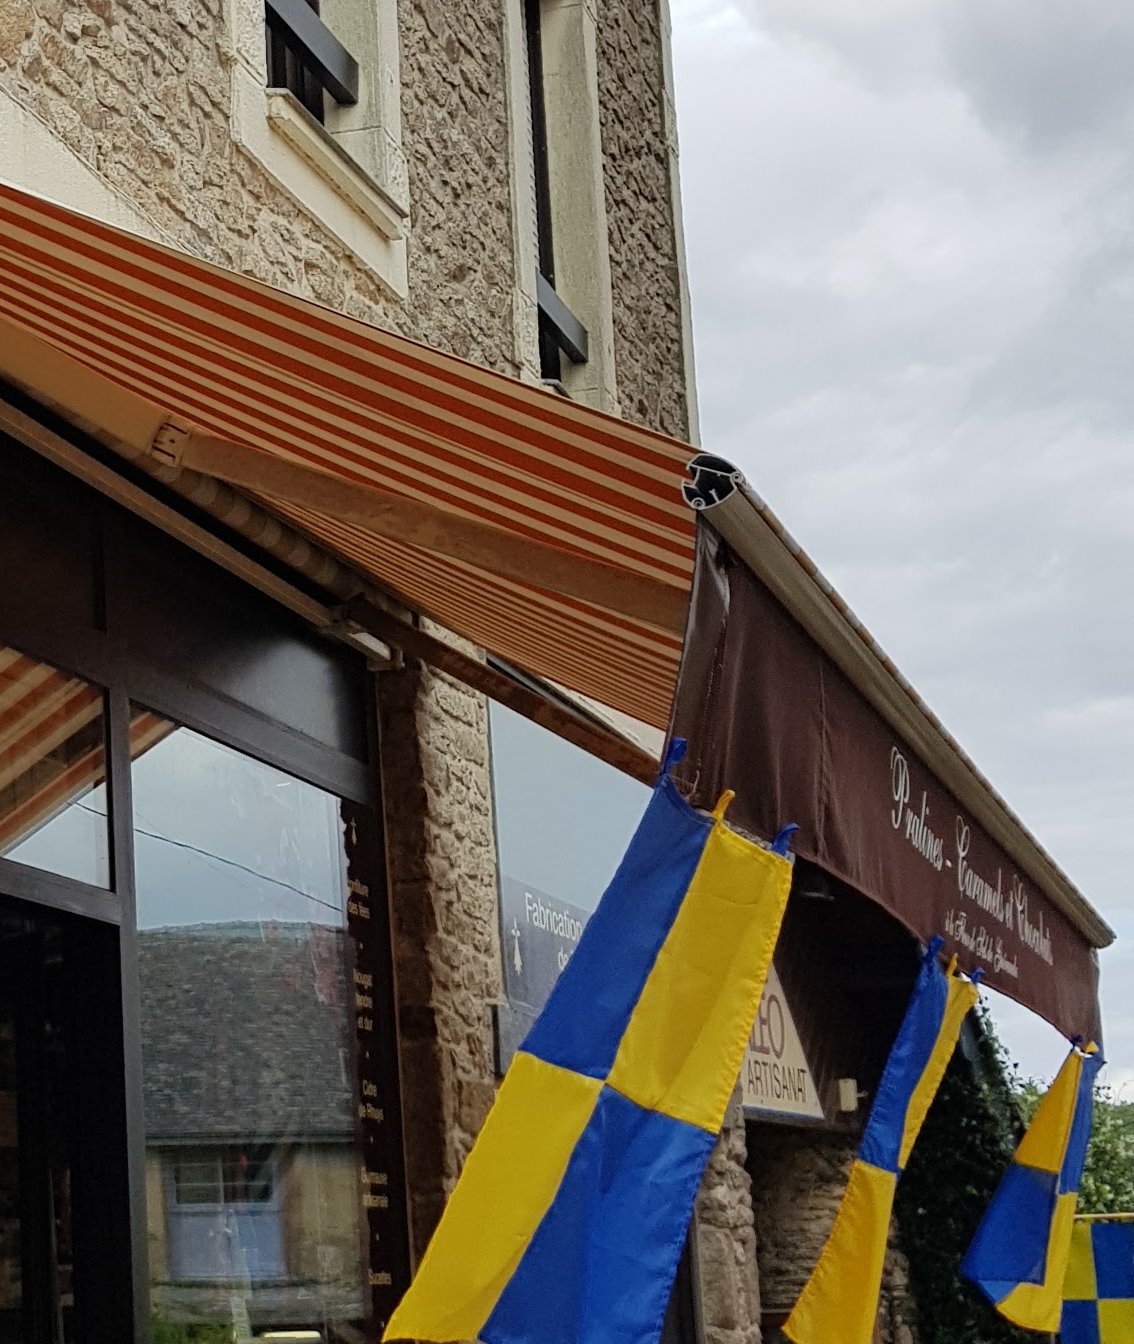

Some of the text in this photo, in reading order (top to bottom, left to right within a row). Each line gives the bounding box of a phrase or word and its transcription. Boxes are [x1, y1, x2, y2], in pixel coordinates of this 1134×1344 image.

[890, 746, 944, 872] Pralines
[524, 892, 583, 942] Fabrication
[747, 1058, 807, 1104] ARTISANAT
